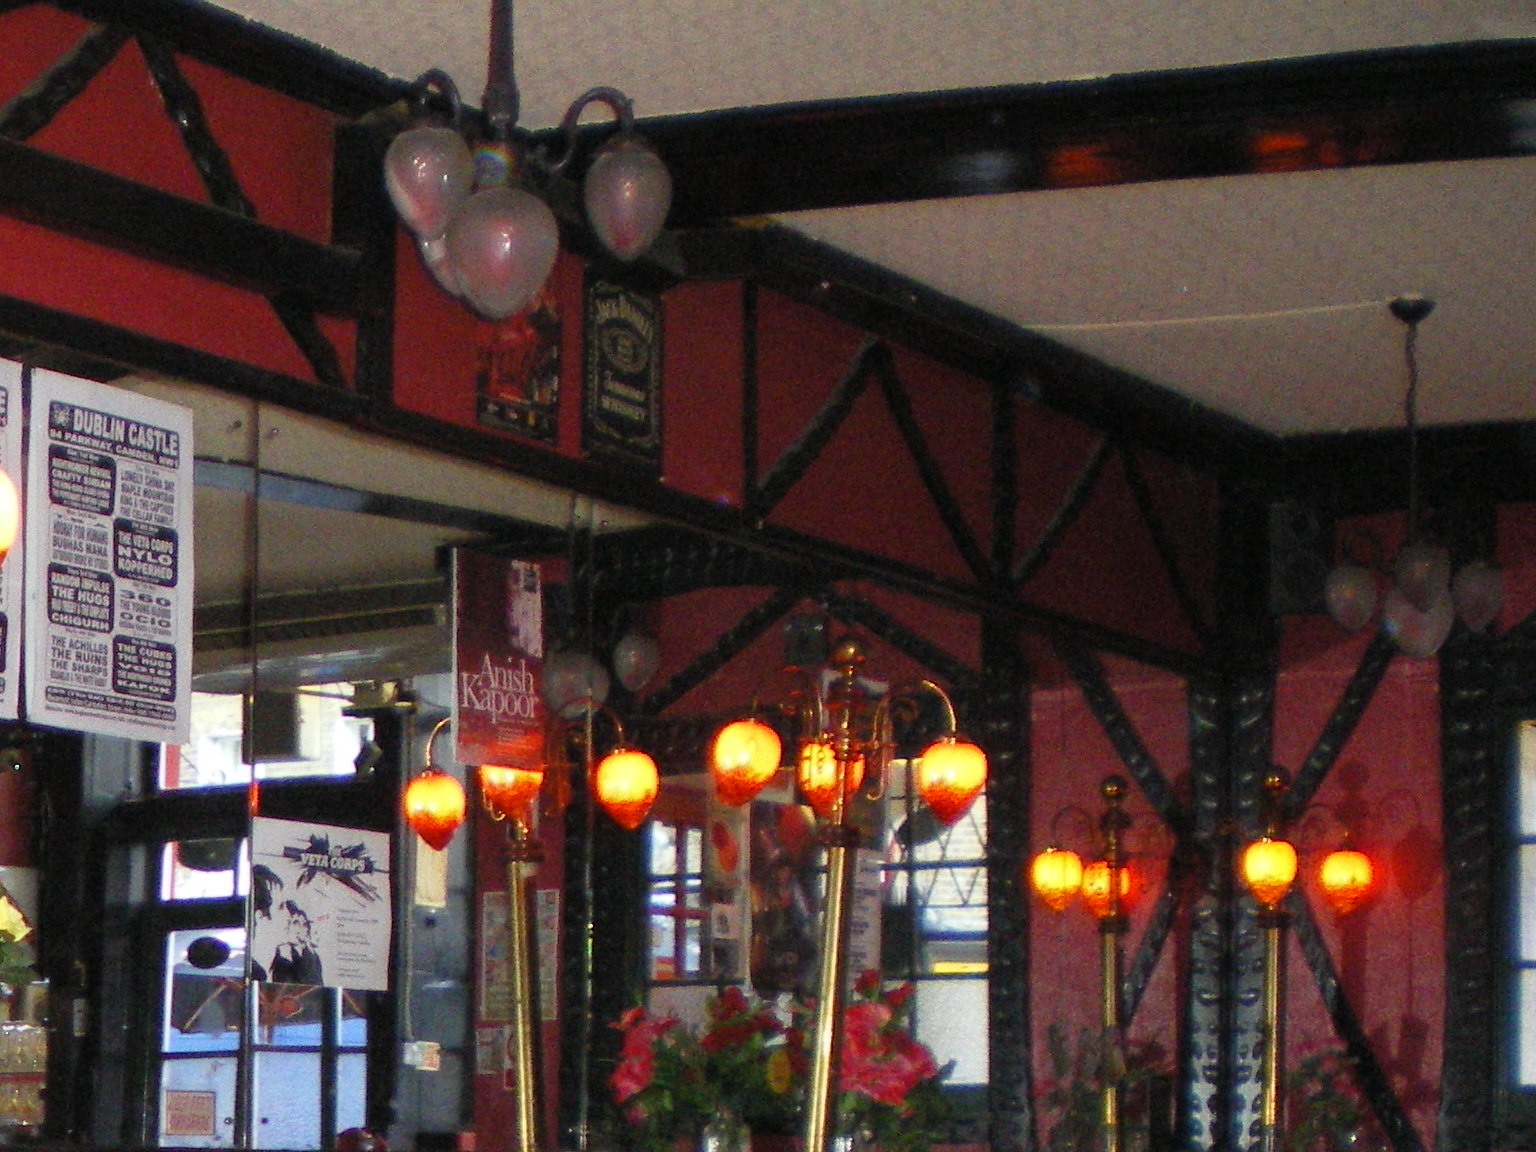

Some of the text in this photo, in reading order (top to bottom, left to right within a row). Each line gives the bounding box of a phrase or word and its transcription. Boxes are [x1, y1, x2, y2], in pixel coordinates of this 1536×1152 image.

[73, 409, 178, 456] DUBLIN CASTLE
[118, 545, 173, 567] NYLO
[52, 585, 110, 607] THE HUGS
[51, 635, 108, 655] THE ACHILLES
[51, 646, 107, 666] THE RUINS
[50, 658, 68, 671] THE
[481, 652, 535, 695] Anish
[461, 671, 539, 724] Kapoor
[300, 852, 366, 872] VETA CORPS
